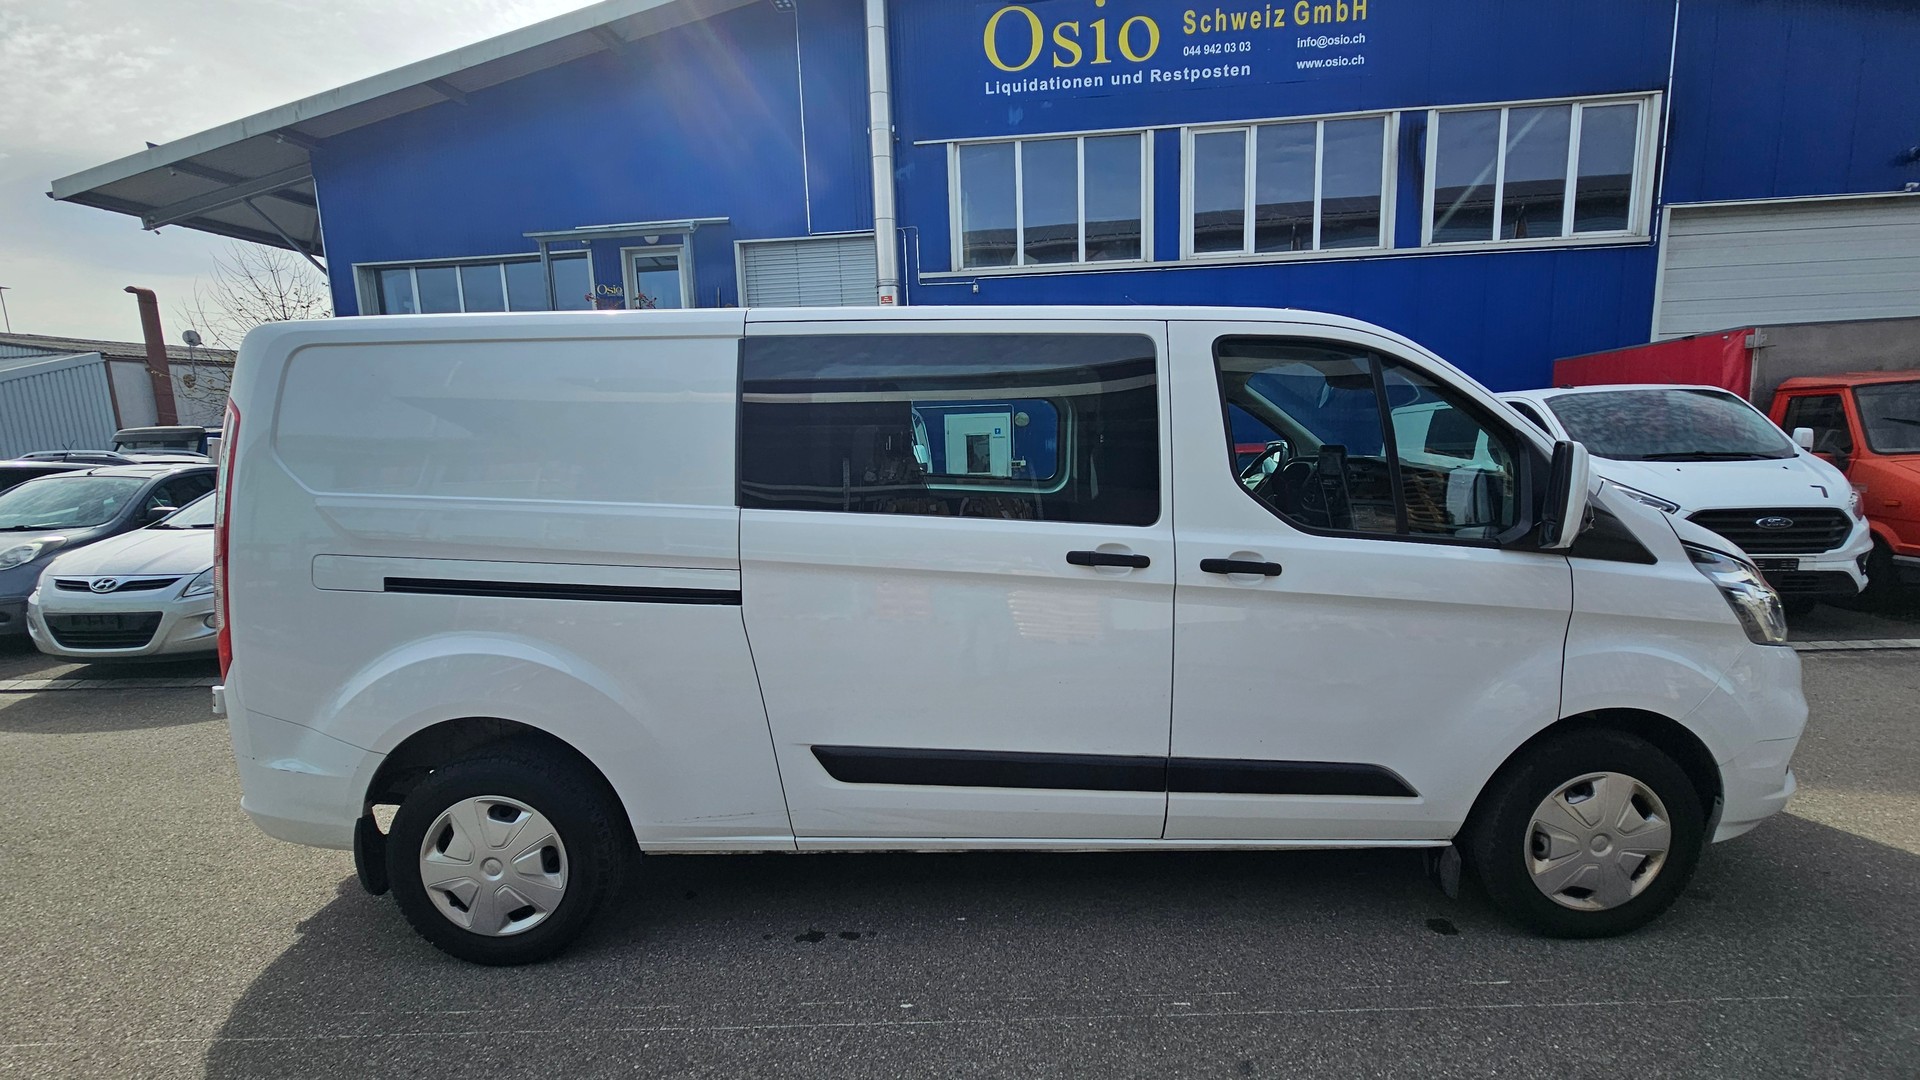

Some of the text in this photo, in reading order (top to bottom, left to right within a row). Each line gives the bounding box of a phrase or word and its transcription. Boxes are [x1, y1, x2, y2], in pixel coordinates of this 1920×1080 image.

[1182, 0, 1367, 35] Schweiz GmbH
[983, 0, 1160, 72] Osio
[1297, 33, 1366, 49] info@osio.ch
[1183, 41, 1251, 56] 044 942 03 03
[1296, 54, 1365, 70] www.osio.ch
[985, 64, 1251, 96] Liquidationen und Restposten
[597, 284, 622, 295] Osio
